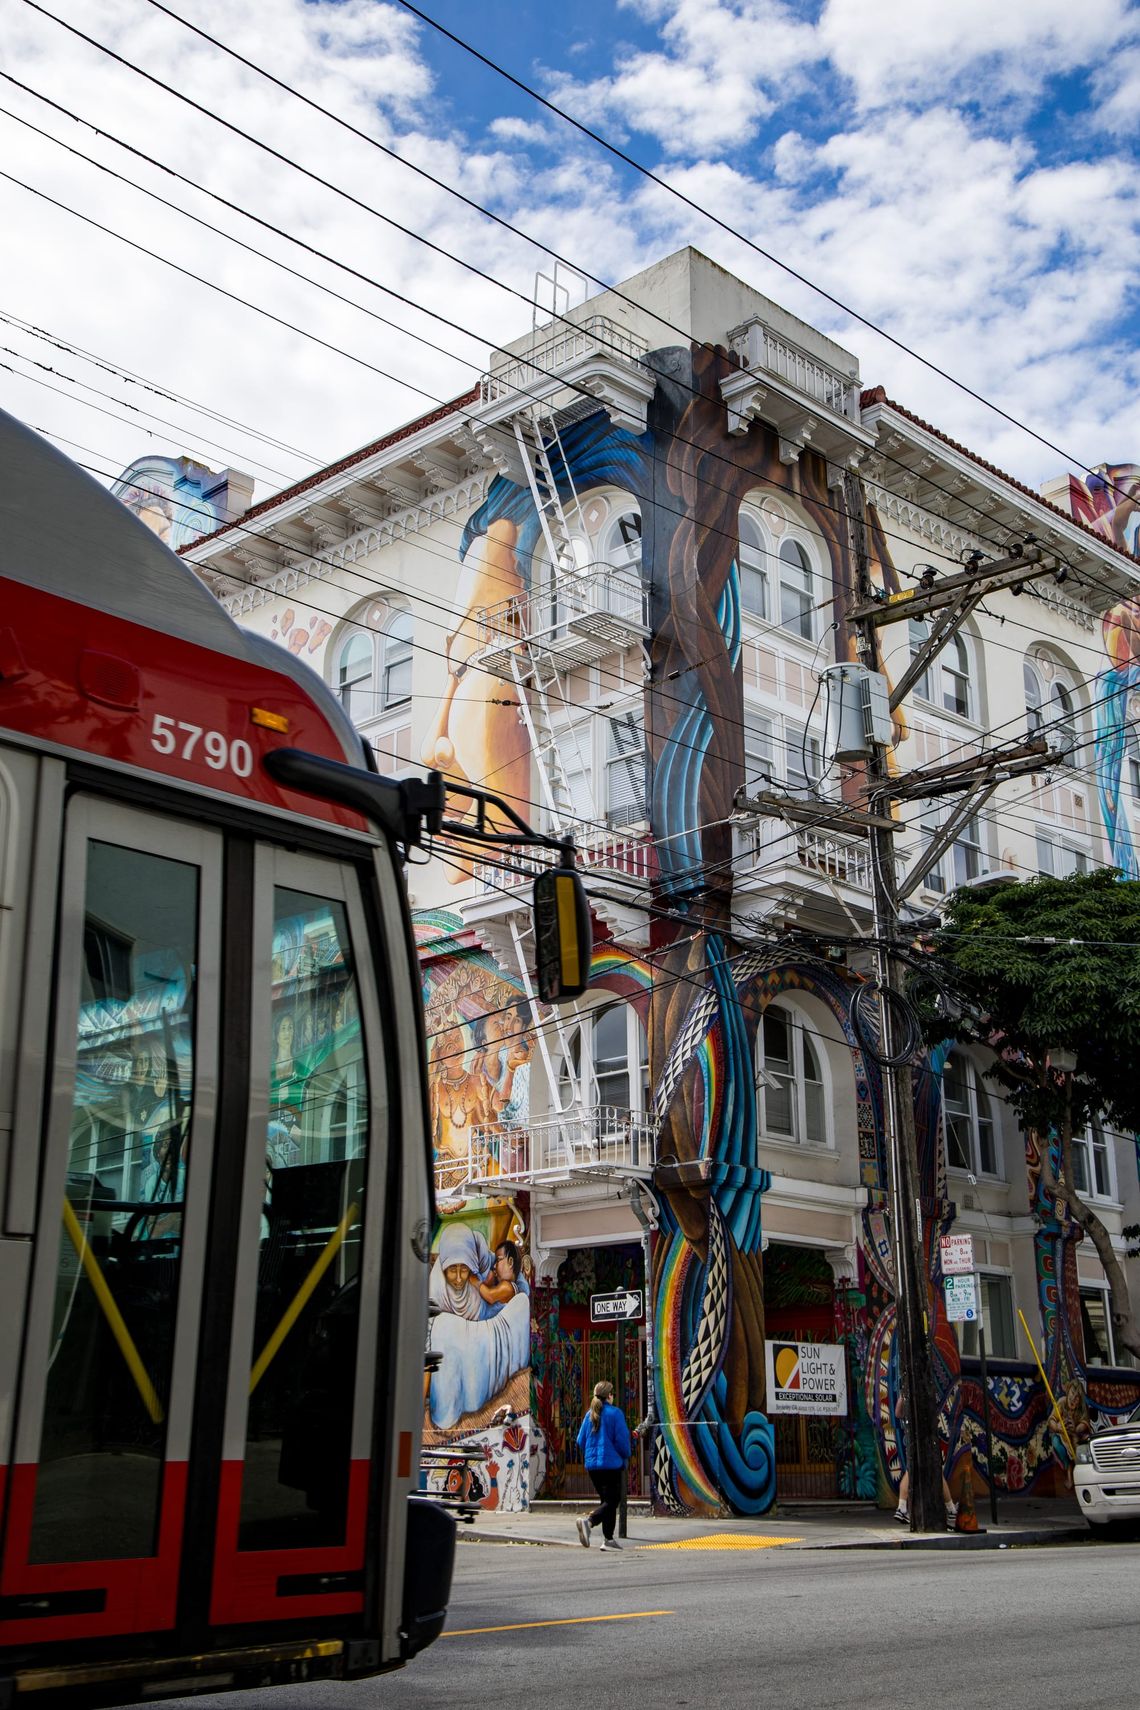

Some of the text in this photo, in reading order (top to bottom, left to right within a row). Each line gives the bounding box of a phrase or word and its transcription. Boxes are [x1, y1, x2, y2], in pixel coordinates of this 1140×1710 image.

[151, 713, 253, 778] 5790
[941, 1236, 971, 1247] NO PARKING
[946, 1278, 954, 1289] 2
[596, 1300, 627, 1314] ONE WAY
[800, 1346, 820, 1359] SUN
[802, 1377, 836, 1391] POWER
[778, 1392, 833, 1403] EXCEPTIONAL SOLAR
